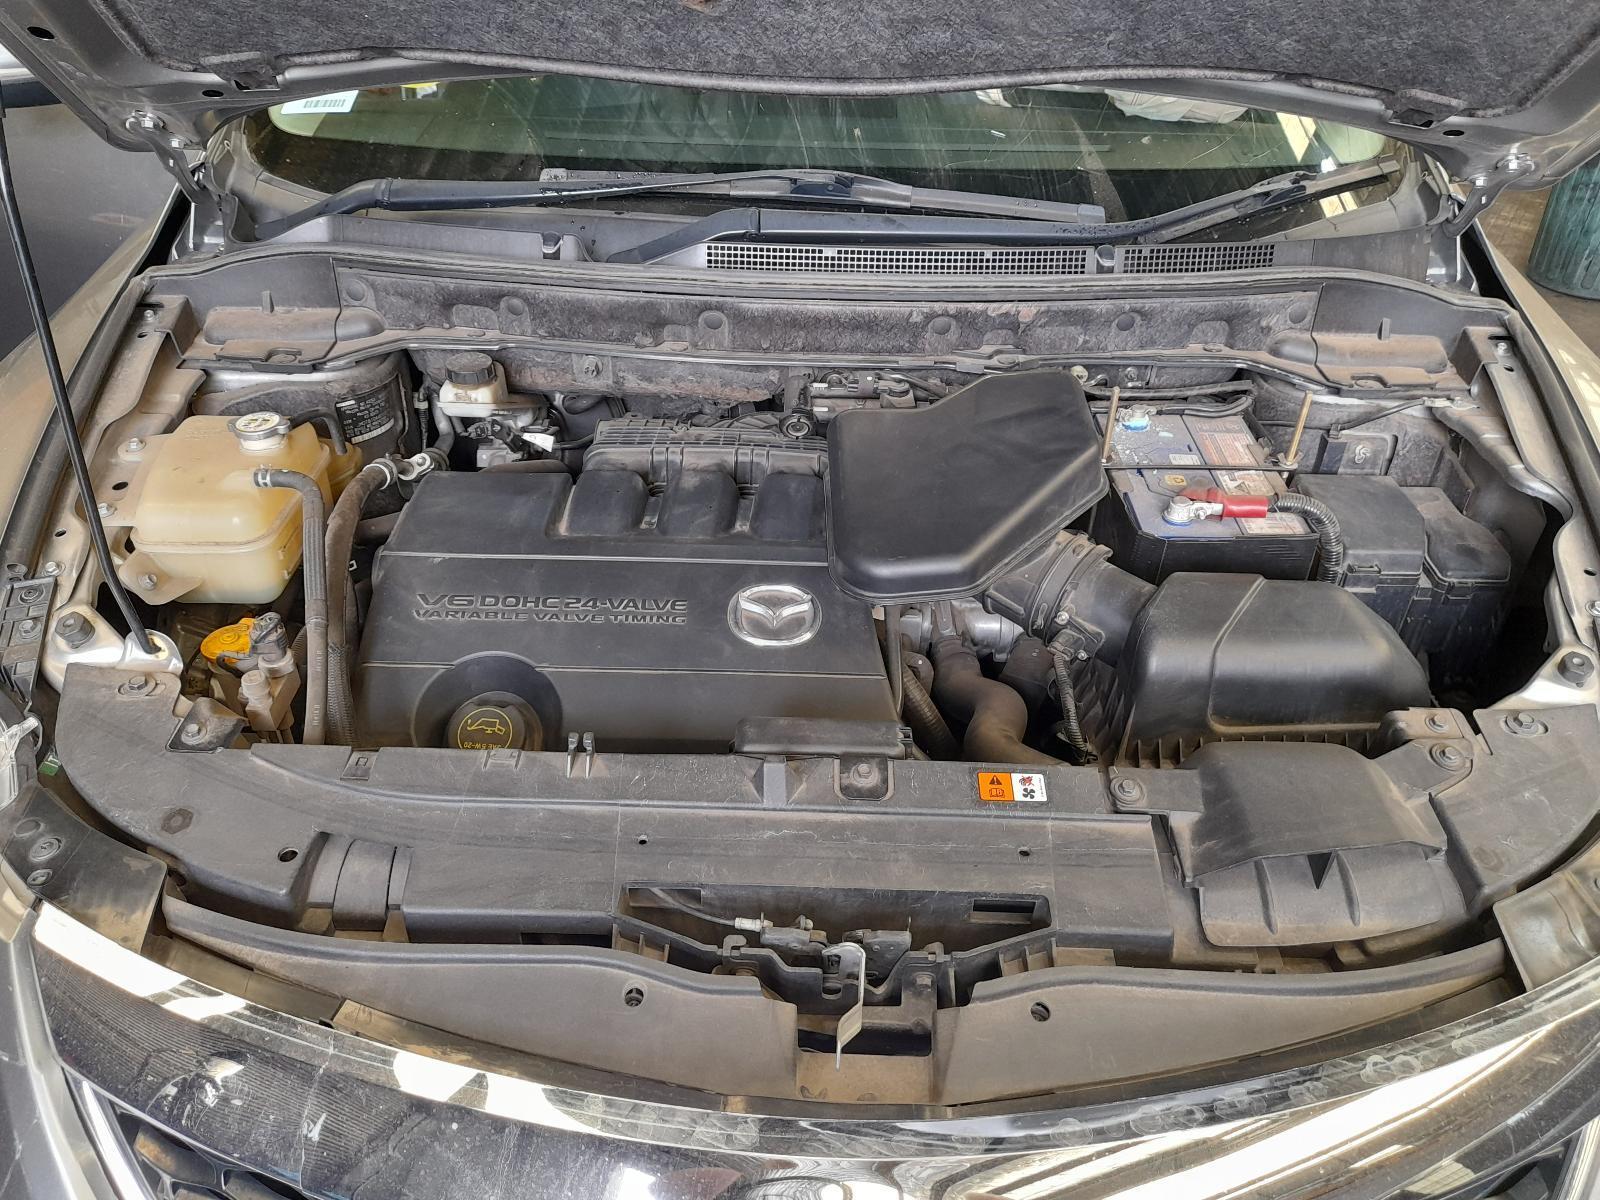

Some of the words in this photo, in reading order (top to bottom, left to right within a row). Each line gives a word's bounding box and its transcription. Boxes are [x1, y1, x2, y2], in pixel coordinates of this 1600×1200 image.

[416, 593, 474, 608] V6
[479, 595, 560, 610] DOHC
[563, 597, 688, 612] 24-VALVE
[413, 609, 529, 620] VARIABLE
[533, 612, 604, 623] VALVE
[609, 614, 687, 624] TIMING
